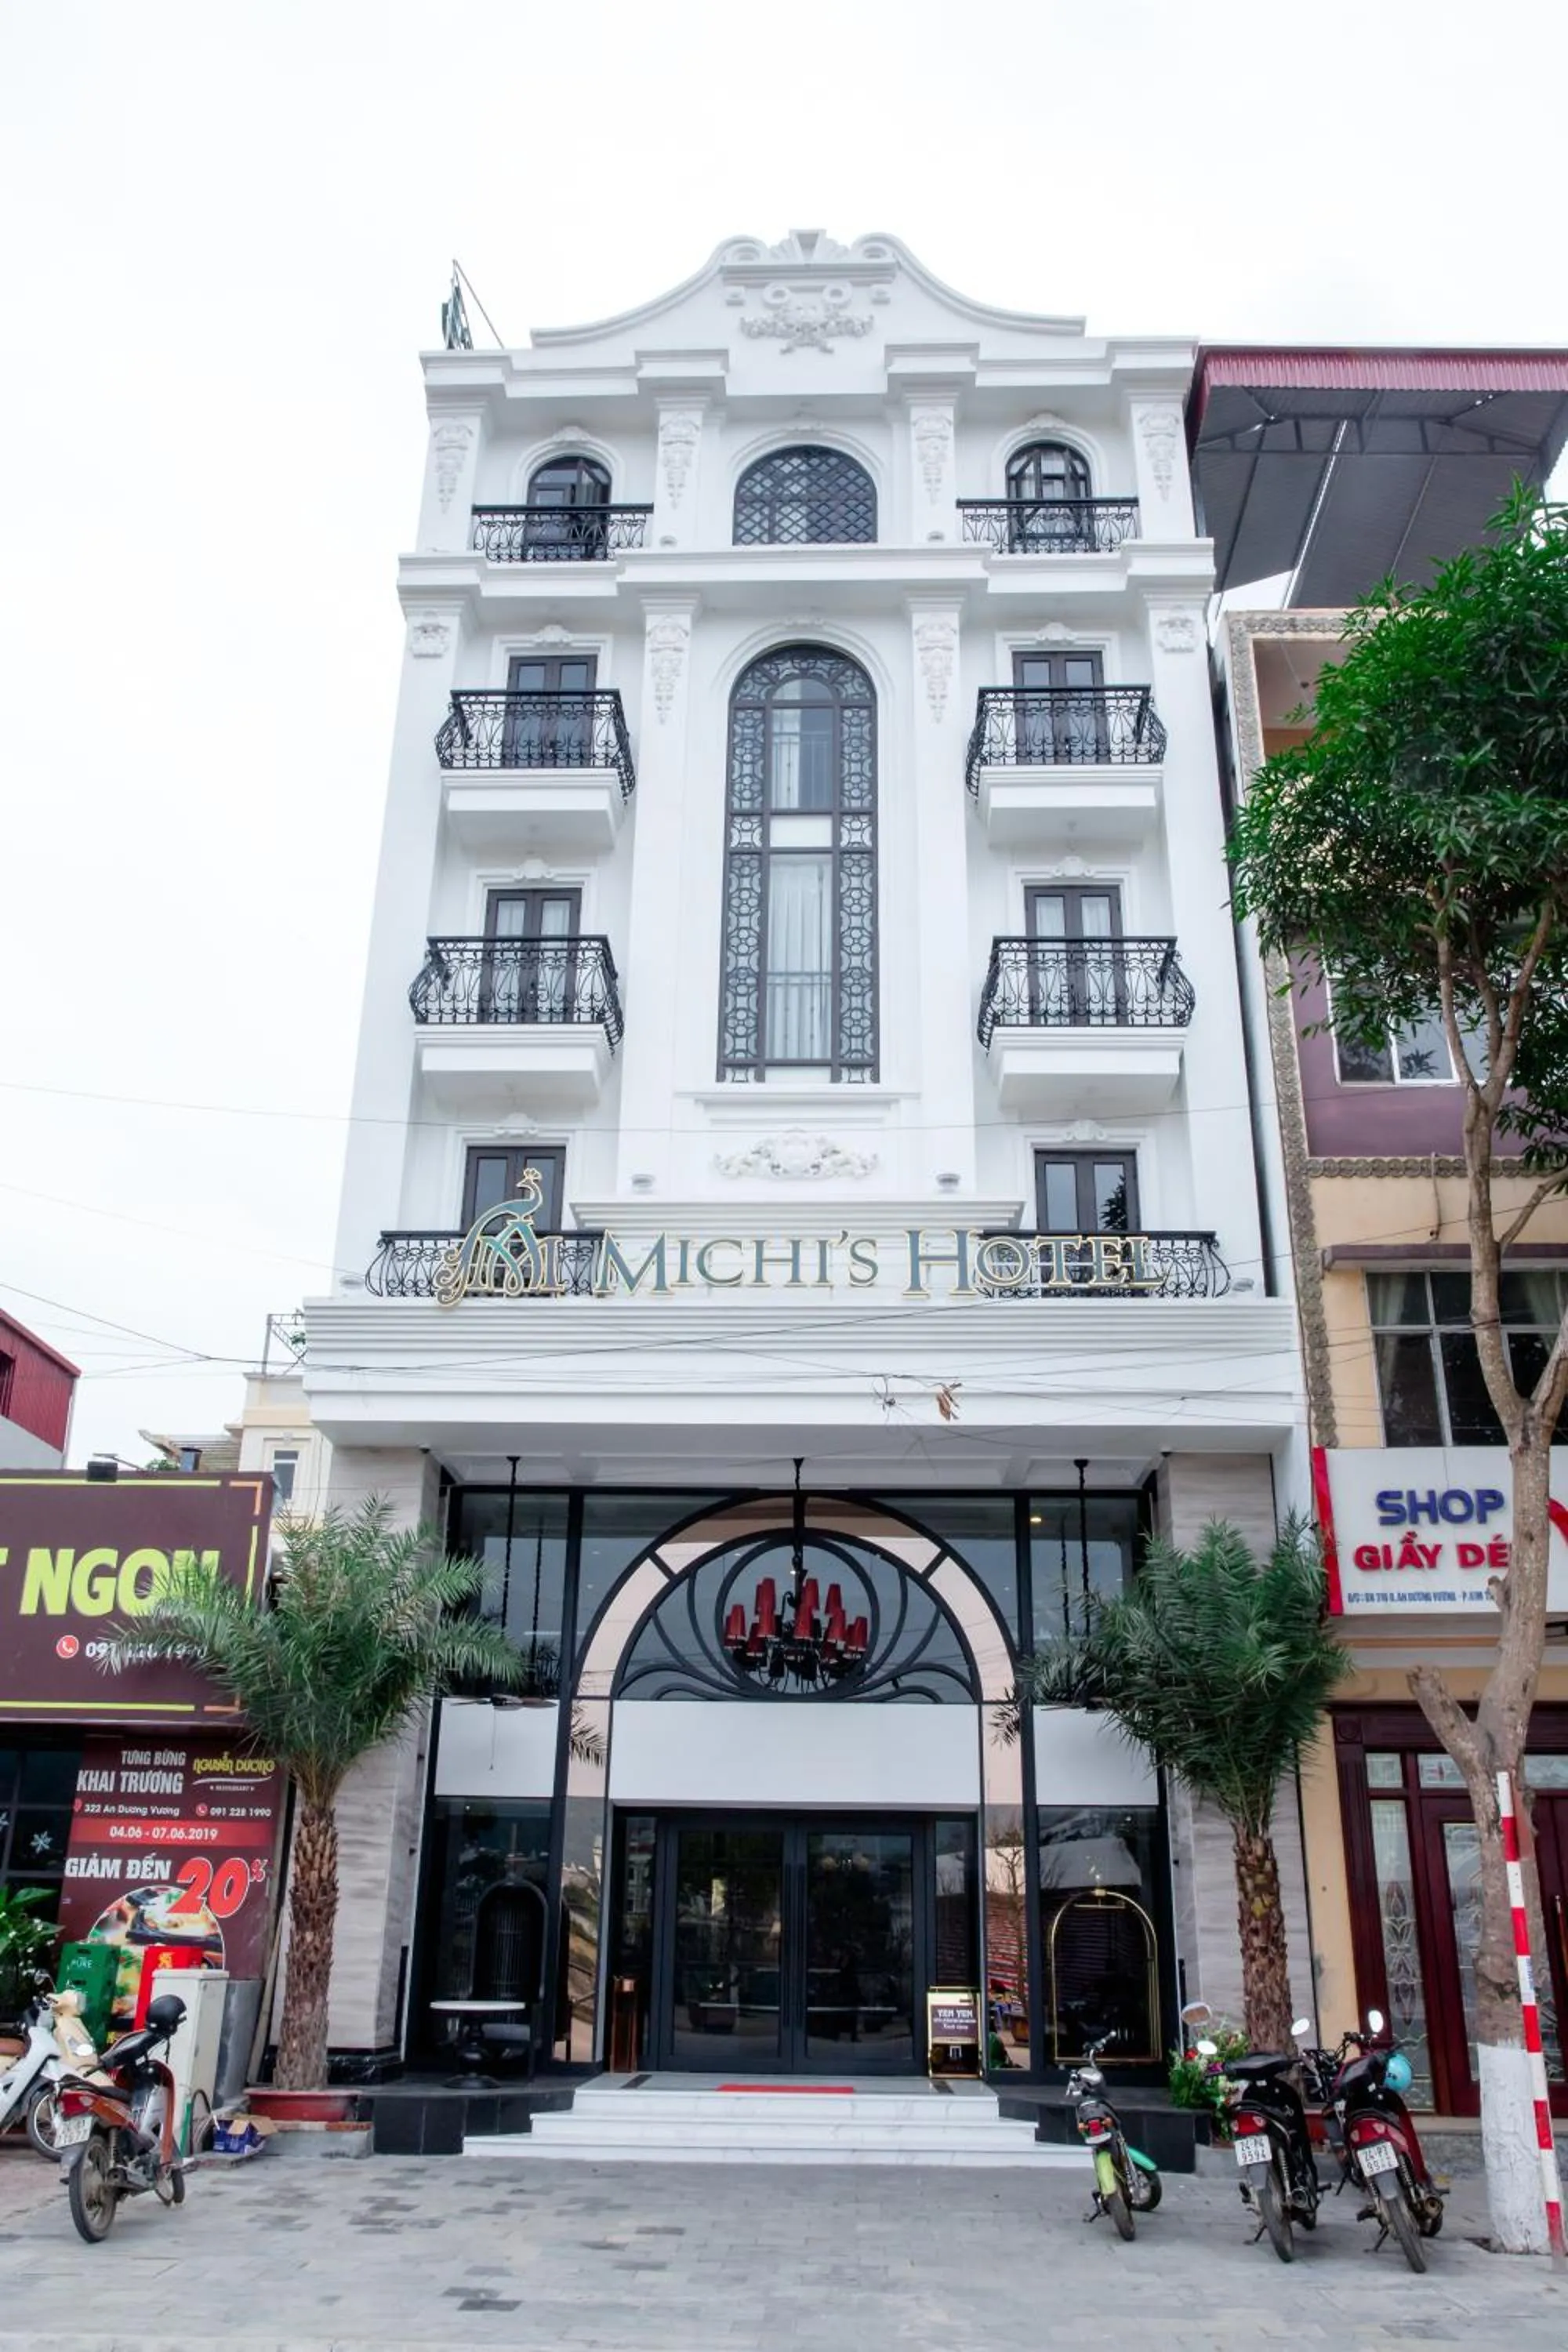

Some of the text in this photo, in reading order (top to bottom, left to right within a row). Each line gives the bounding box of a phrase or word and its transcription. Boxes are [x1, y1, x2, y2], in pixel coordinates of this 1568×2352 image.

[594, 1228, 879, 1298] MICHI'S
[902, 1227, 1167, 1297] HOTEL
[1375, 1489, 1504, 1526] SHOP
[1456, 1534, 1513, 1569] DÉ
[76, 1769, 115, 1791] KHAI
[109, 1826, 142, 1838] 04.06
[152, 1828, 218, 1840] 07.06.2019
[64, 1853, 122, 1878] GIẢM
[125, 1853, 172, 1879] ĐẾN
